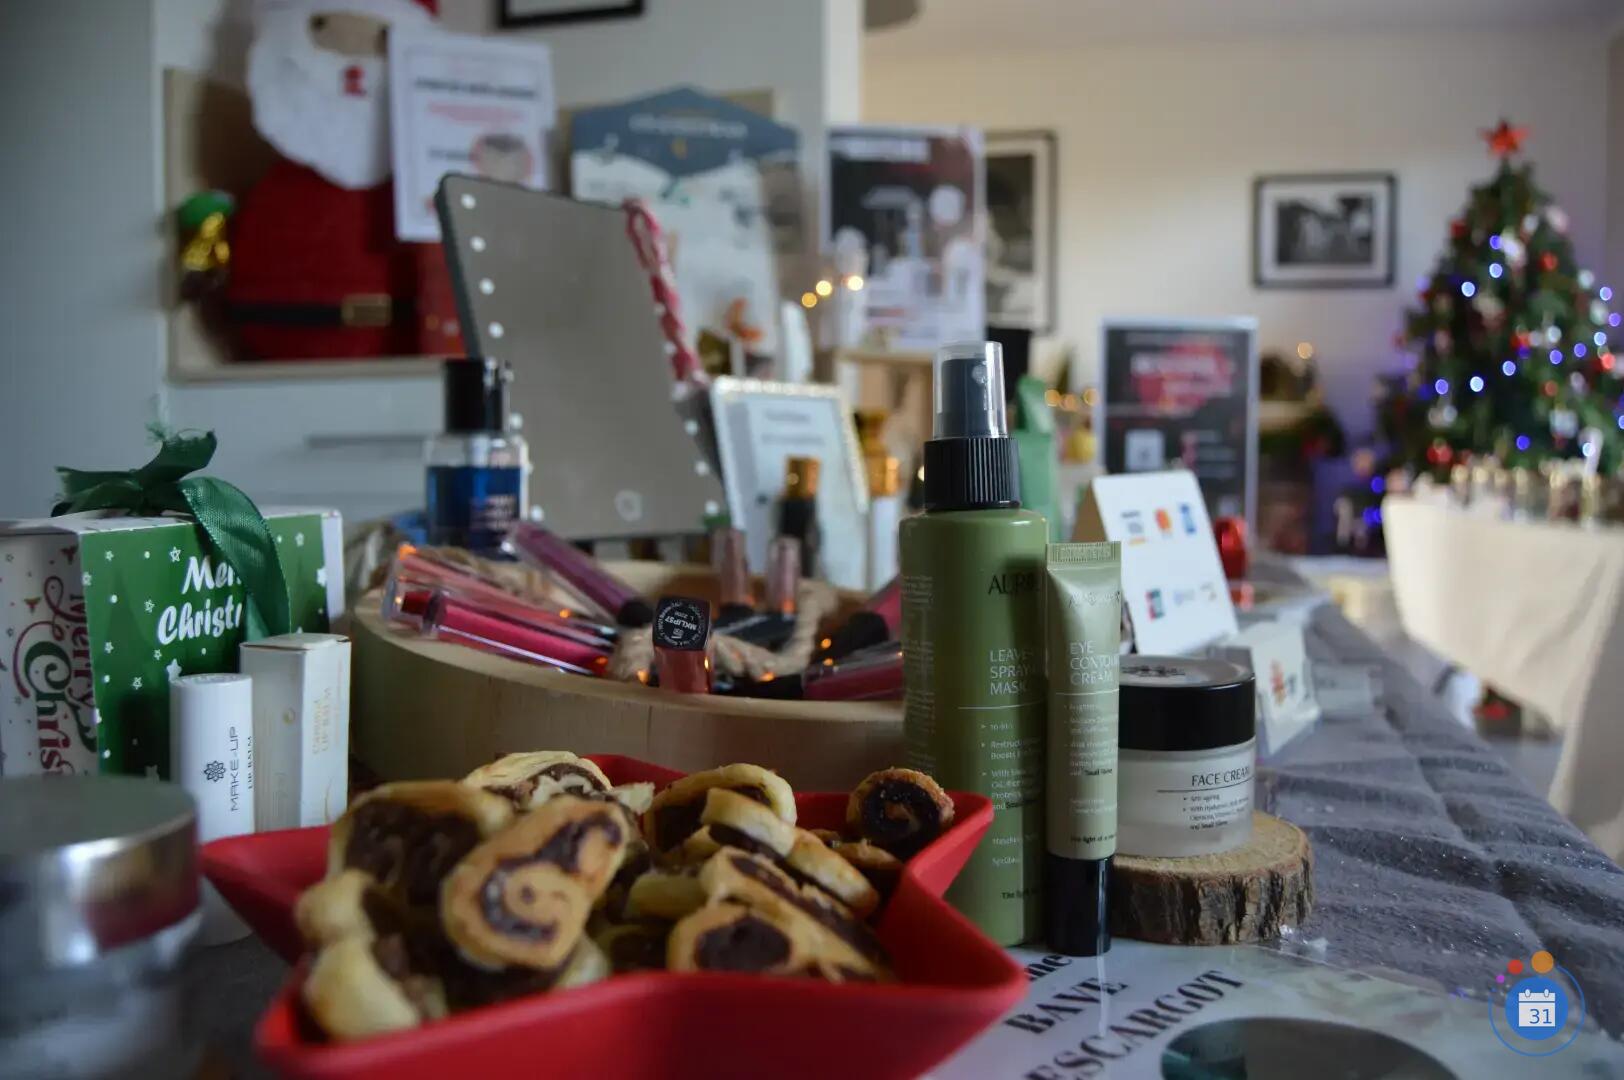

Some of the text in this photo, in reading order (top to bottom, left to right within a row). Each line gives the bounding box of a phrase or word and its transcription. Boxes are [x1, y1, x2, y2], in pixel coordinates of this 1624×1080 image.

[157, 594, 243, 645] Christ
[1070, 640, 1097, 655] EYE
[990, 664, 1030, 678] SPRAY
[1070, 669, 1114, 686] CREAM
[990, 680, 1029, 696] MASK
[24, 640, 76, 776] Chris
[229, 726, 239, 812] MAKE-UP
[1191, 773, 1221, 787] FACE
[1003, 976, 1130, 1035] BAVE
